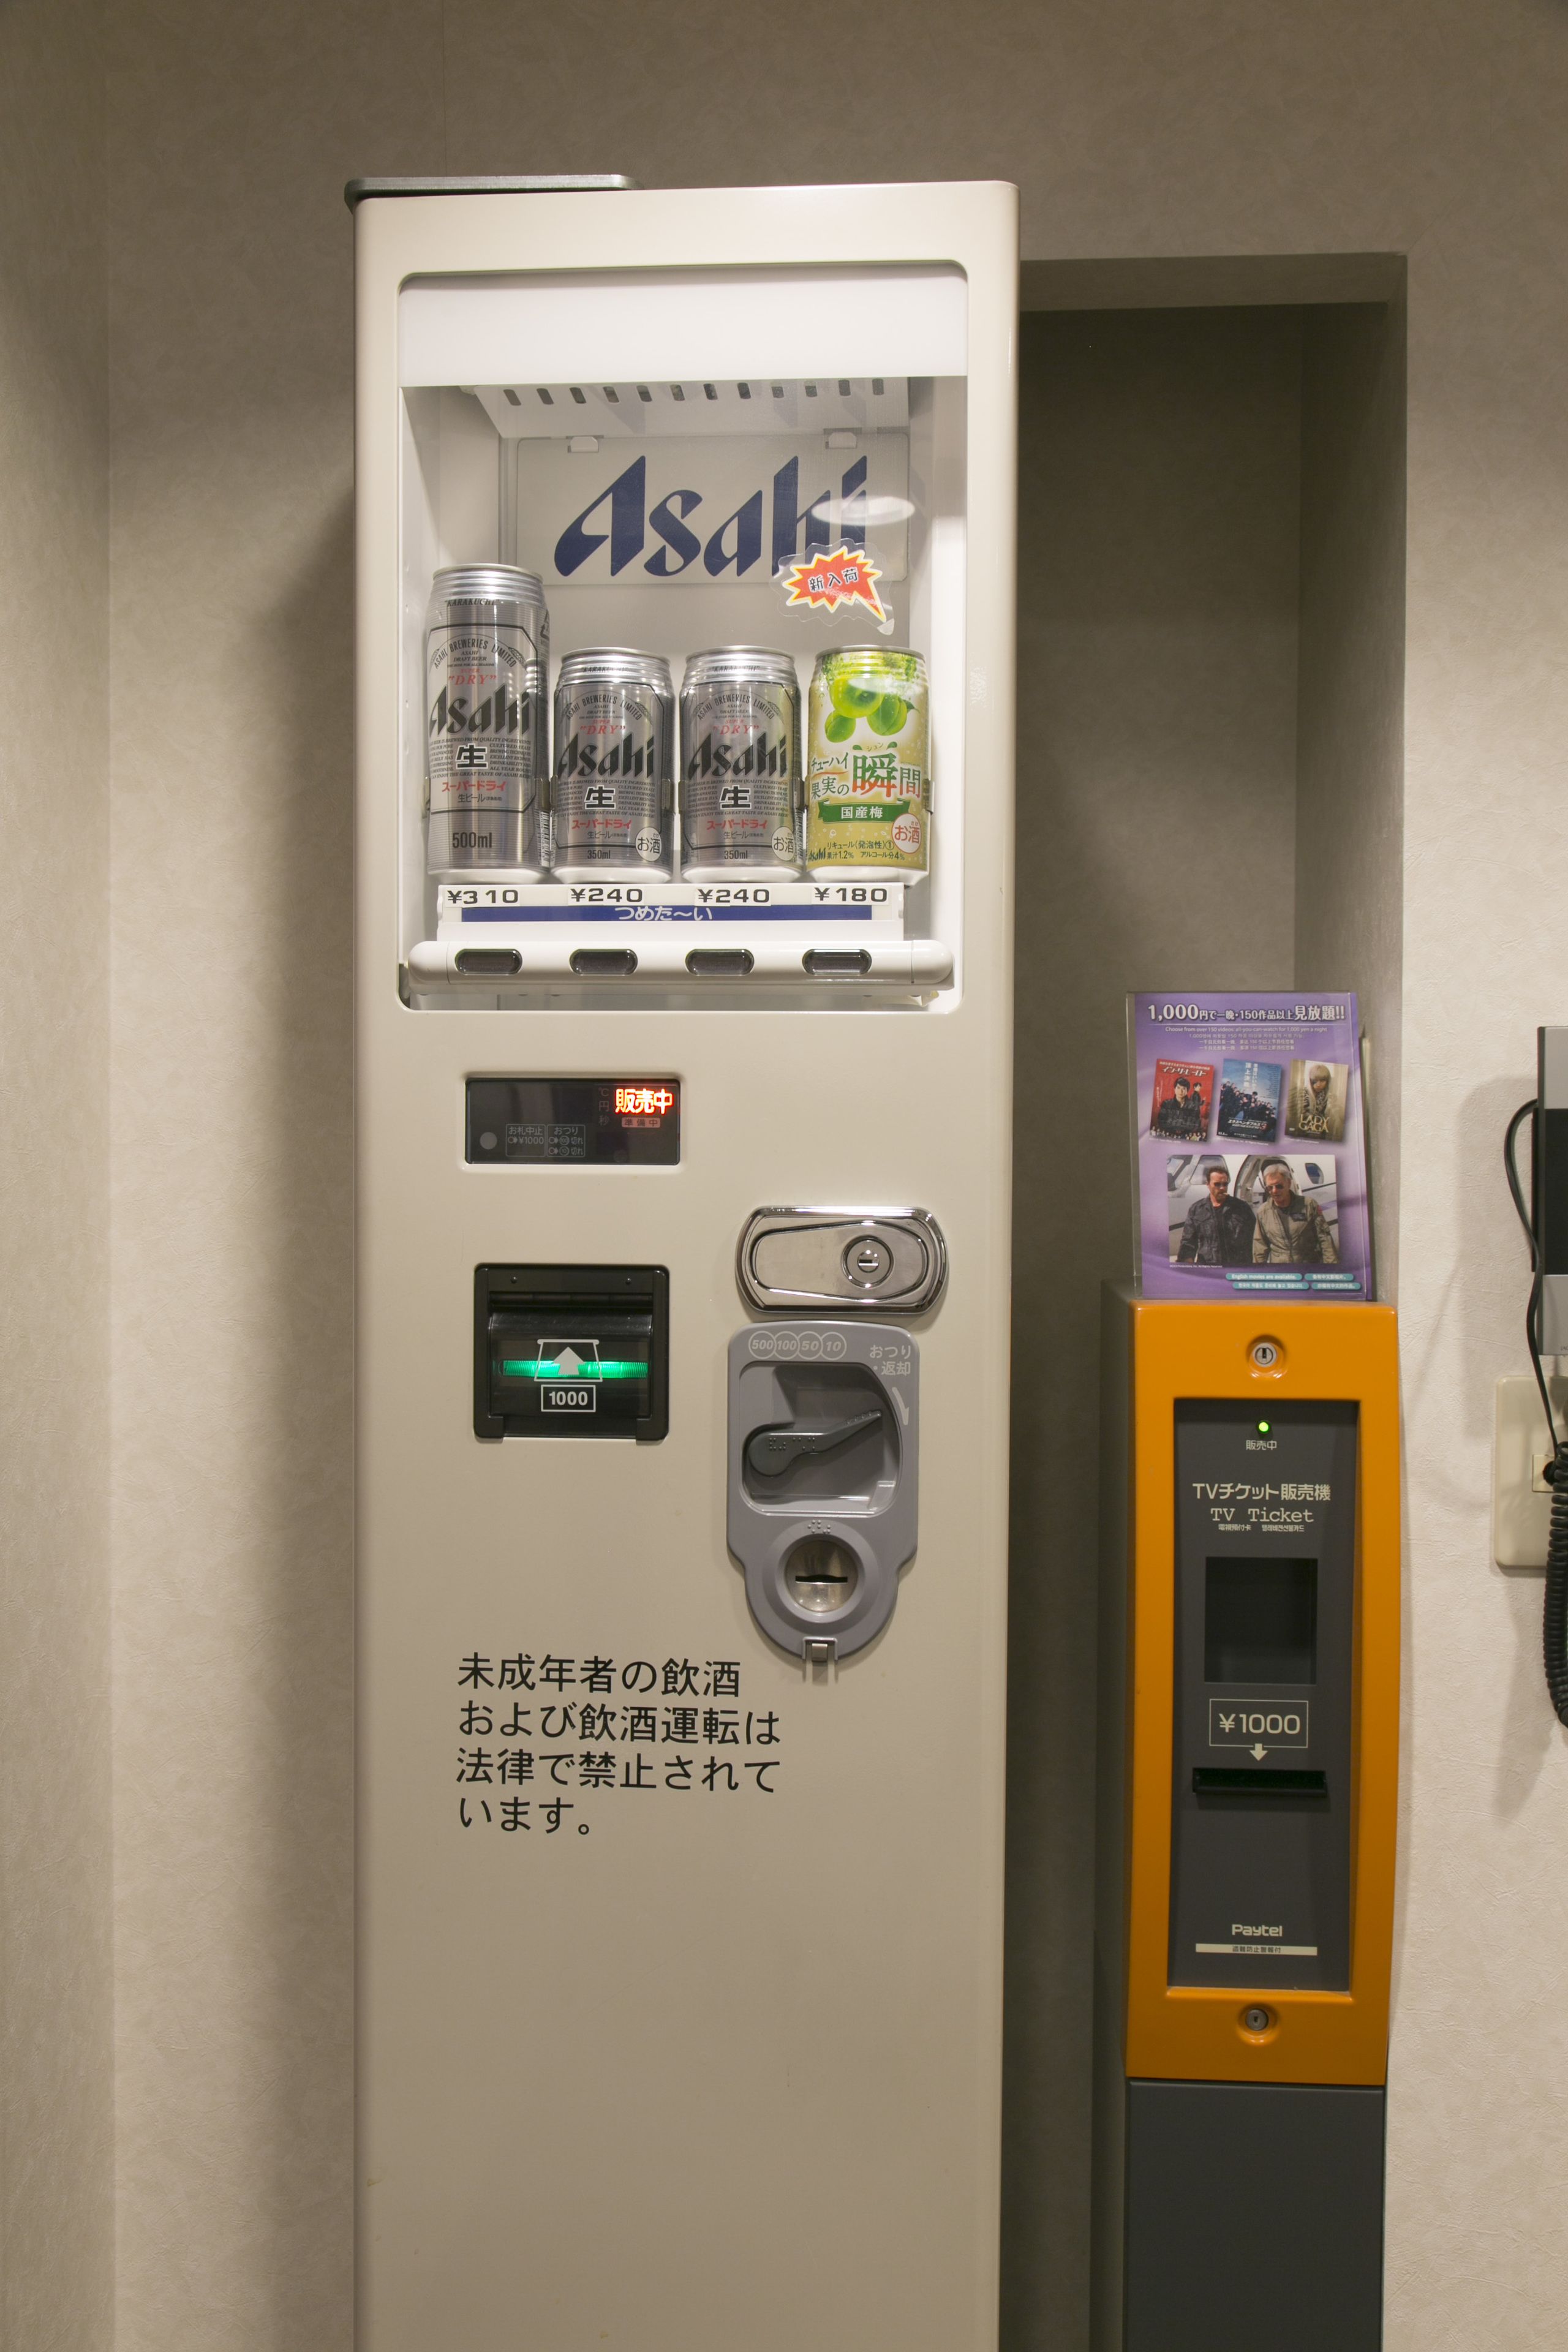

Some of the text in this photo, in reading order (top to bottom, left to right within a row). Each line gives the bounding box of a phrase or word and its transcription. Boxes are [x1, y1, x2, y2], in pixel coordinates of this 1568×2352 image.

[554, 455, 867, 577] Asahi
[809, 567, 858, 592] 新入荷
[434, 638, 518, 669] ASAHI BREWERIES LIMITED
[429, 684, 530, 737] Asahi
[566, 694, 643, 721] ASAHI BREWERIES LIMITED
[697, 704, 714, 721] ASAHI
[753, 698, 775, 720] LIMITED
[867, 742, 884, 752] シュン
[456, 743, 488, 769] 生
[557, 732, 654, 780] Asahi
[687, 731, 787, 780] Asahi
[811, 752, 849, 772] チューハイ
[811, 752, 922, 799] 果実の 瞬間
[442, 780, 507, 793] スーパードライ
[458, 794, 484, 803] 生ビール
[584, 785, 616, 810] 生
[719, 785, 752, 810] 生
[840, 805, 884, 819] 国産梅
[571, 818, 633, 830] スーパードライ
[706, 819, 767, 831] スーパードライ
[452, 832, 492, 848] 500ml
[587, 831, 611, 839] 生ビール
[724, 831, 748, 840] 生ビール
[894, 824, 920, 844] お酒
[637, 837, 660, 854] お酒
[773, 836, 794, 853] お酒
[587, 850, 611, 859] 350ml
[724, 850, 748, 859] 350ml
[827, 850, 905, 861] 果汁1.2% アルコール分4%
[447, 887, 888, 905] ¥310 ¥240 ¥240 ¥180
[598, 1100, 609, 1112] 円
[614, 1088, 673, 1115] 販売中
[625, 1118, 658, 1127] 準備中
[1298, 1121, 1329, 1133] GAGA
[1300, 1114, 1330, 1126] LADY
[508, 1126, 543, 1136] お札中止
[554, 1126, 578, 1136] おつり
[752, 1340, 842, 1351] 500 100 50 10
[870, 1344, 911, 1359] おつり
[549, 1391, 588, 1406] 1000
[1246, 1439, 1277, 1450] 販売中
[1192, 1483, 1331, 1501] TVチケット販売機
[1210, 1507, 1314, 1523] TV Ticket
[458, 1652, 741, 1698] 未成年者の飲酒
[459, 1700, 781, 1746] および飲酒運転は
[1218, 1713, 1301, 1735] ¥1000
[456, 1747, 780, 1793] 法律で禁止されて
[459, 1796, 589, 1836] います。
[1231, 1924, 1283, 1937] Paytel
